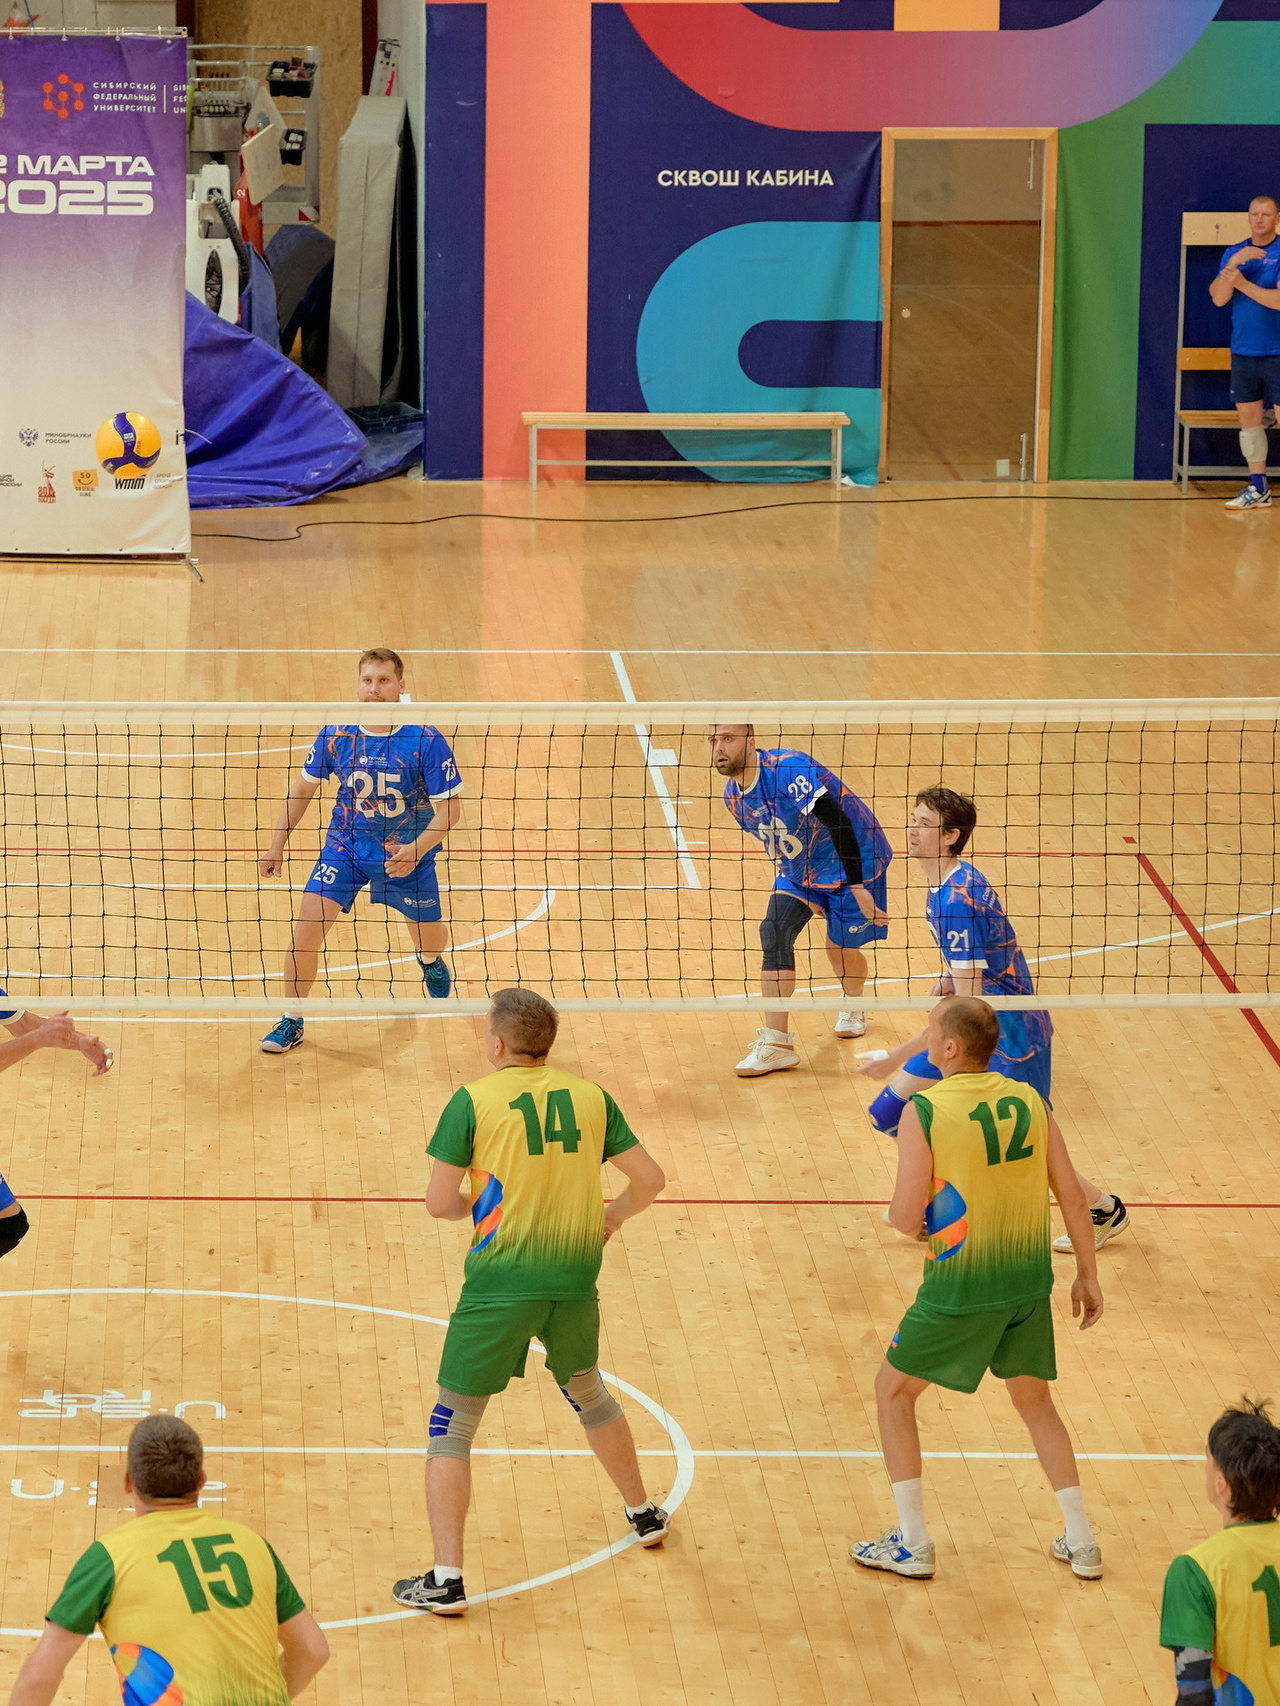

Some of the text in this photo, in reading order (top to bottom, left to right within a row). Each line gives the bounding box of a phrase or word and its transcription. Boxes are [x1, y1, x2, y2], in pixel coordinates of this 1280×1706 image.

[92, 81, 157, 90] СИБИРСКИЙ
[92, 92, 157, 102] ФЕДЕРАЛЬНЫЙ
[93, 103, 157, 113] УНИВЕРСИТЕТ
[17, 154, 156, 176] МАРТА
[657, 169, 835, 187] СКВОШ КАБИНА
[347, 770, 407, 818] 25
[787, 775, 813, 803] 28
[312, 863, 339, 885] 25
[946, 929, 970, 953] 21
[509, 1087, 582, 1156] 14
[968, 1095, 1035, 1167] 12
[156, 1533, 255, 1615] 15
